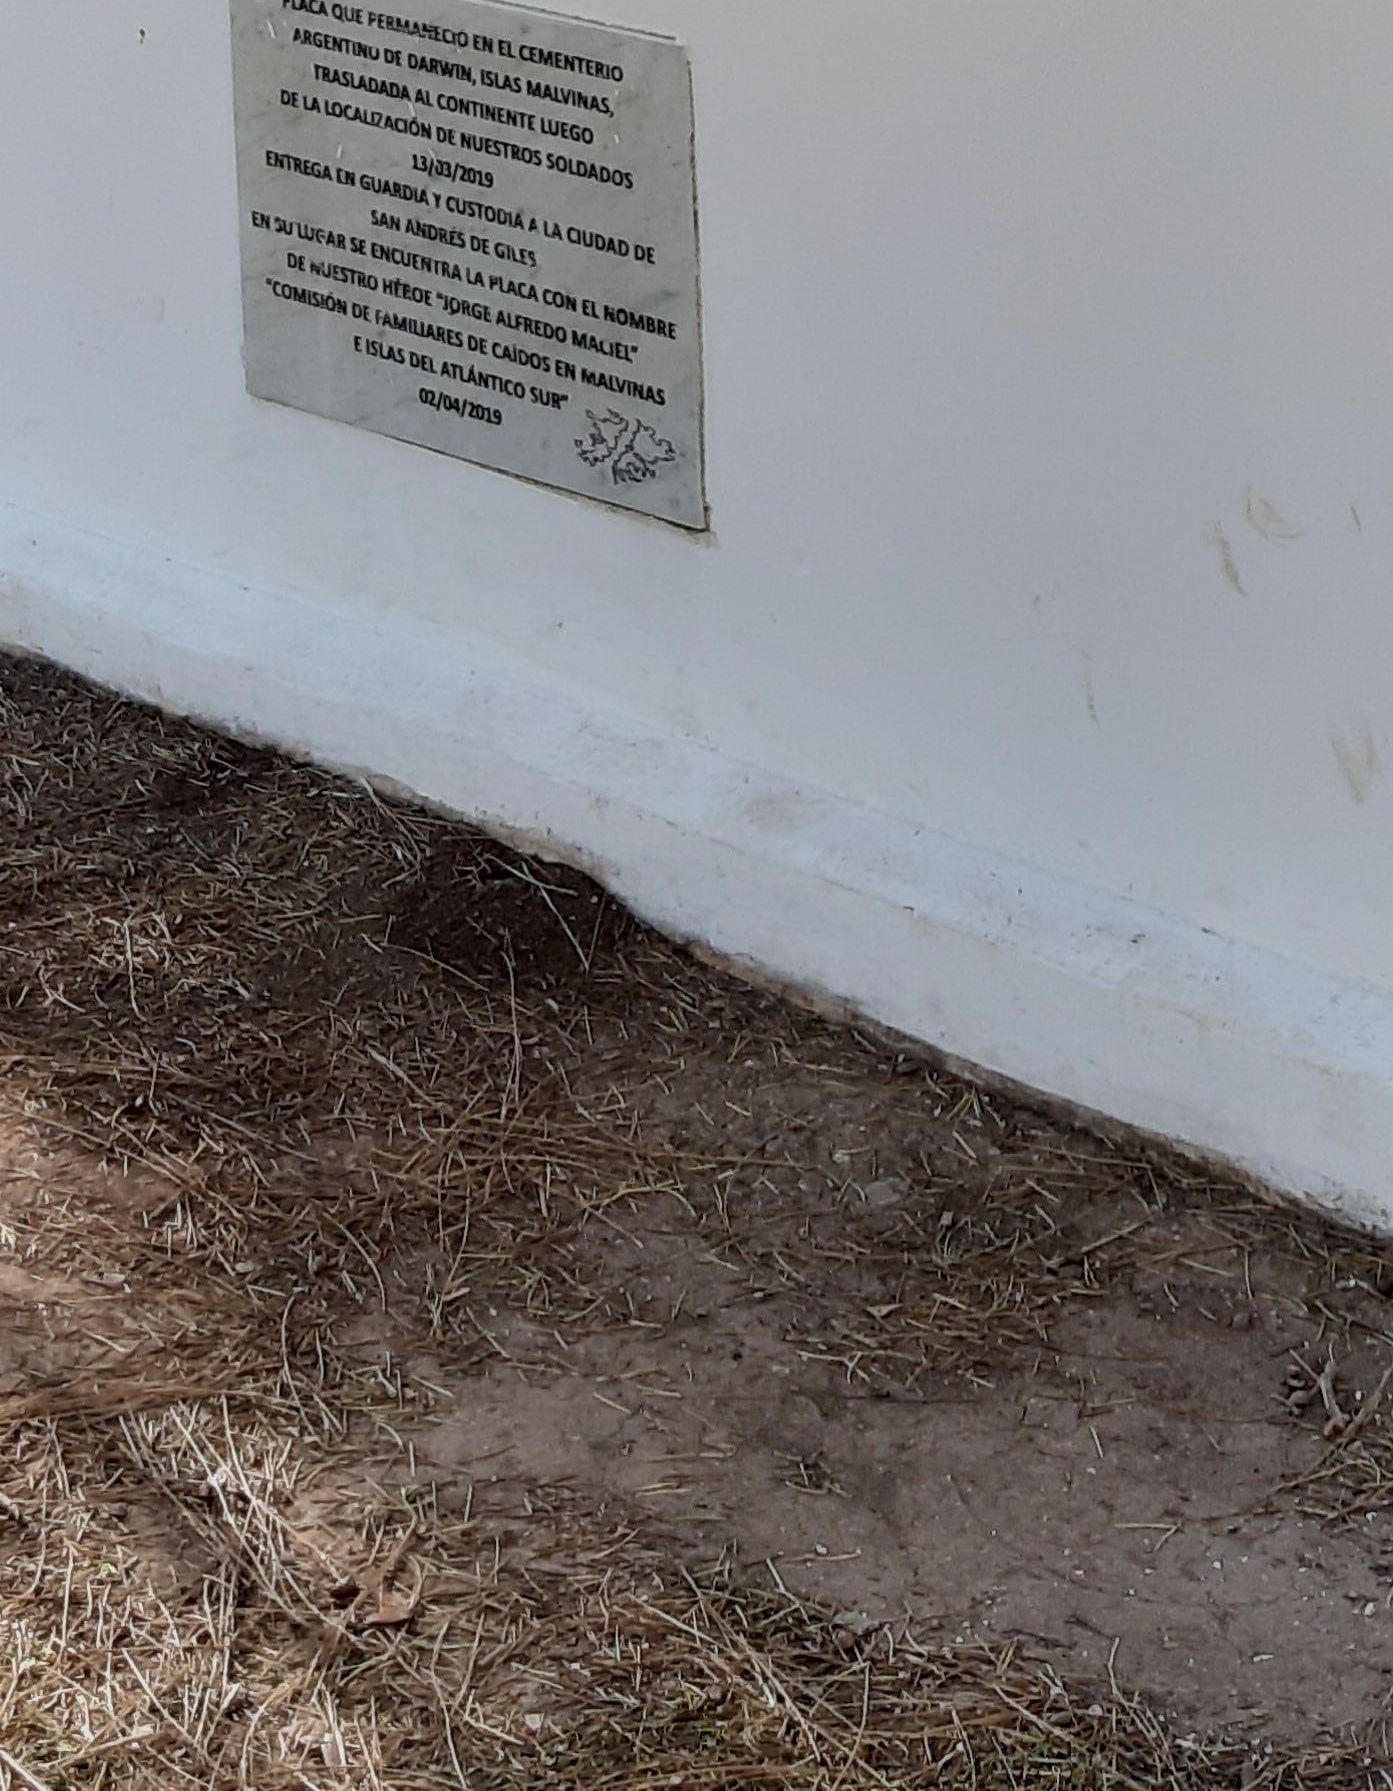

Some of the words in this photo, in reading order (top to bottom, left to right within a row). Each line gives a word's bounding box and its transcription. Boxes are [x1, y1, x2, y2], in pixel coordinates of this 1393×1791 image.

[331, 3, 364, 25] QUE
[472, 33, 494, 54] EN
[497, 38, 517, 59] EL
[518, 44, 624, 83] CEMENTERIO
[383, 47, 403, 67] DE
[407, 52, 477, 87] DARWIN,
[480, 68, 522, 94] ISLAS
[526, 79, 615, 119] MALVINAS,
[280, 89, 299, 109] DE
[302, 95, 321, 114] LA
[324, 99, 432, 140] LOCALIZACIÓN
[435, 126, 457, 147] DE
[460, 131, 543, 167] NUESTROS
[545, 152, 634, 190] SOLDADOS
[313, 63, 412, 102] TRASLADADA
[414, 88, 434, 108] AL
[436, 93, 537, 132] CONTINENTE
[540, 116, 594, 145] LUEGO
[265, 149, 334, 182] ENTREGA
[335, 167, 356, 187] EN
[359, 173, 430, 207] GUARDIA
[431, 192, 442, 209] Y
[445, 195, 525, 231] CUSTODIA
[527, 217, 538, 233] A
[543, 220, 563, 241] LA
[566, 226, 630, 257] CIUDAD
[633, 244, 656, 266] DE
[370, 209, 401, 232] SAN
[404, 218, 467, 249] ANDRÉS
[469, 235, 491, 256] DE
[493, 241, 537, 268] GILES
[251, 210, 271, 231] EN
[349, 236, 367, 256] SE
[370, 242, 463, 282] ENCUENTRA
[465, 267, 486, 288] LA
[488, 275, 539, 303] PLACA
[542, 288, 577, 313] CON
[581, 298, 601, 320] EL
[603, 304, 677, 341] NOMBRE
[287, 252, 306, 272] DE
[495, 309, 568, 344] ALFREDO
[351, 302, 372, 323] DE
[374, 309, 464, 348] FAMILIARES
[467, 334, 488, 356] DE
[491, 341, 551, 373] CAÍDOS
[554, 359, 577, 382] EN
[580, 367, 666, 406] MALVINAS
[353, 335, 363, 353] E
[365, 338, 406, 365] ISLAS
[408, 351, 438, 375] DEL
[440, 360, 526, 400] ATLÁNTICO
[418, 387, 503, 426] 02/04/2019
